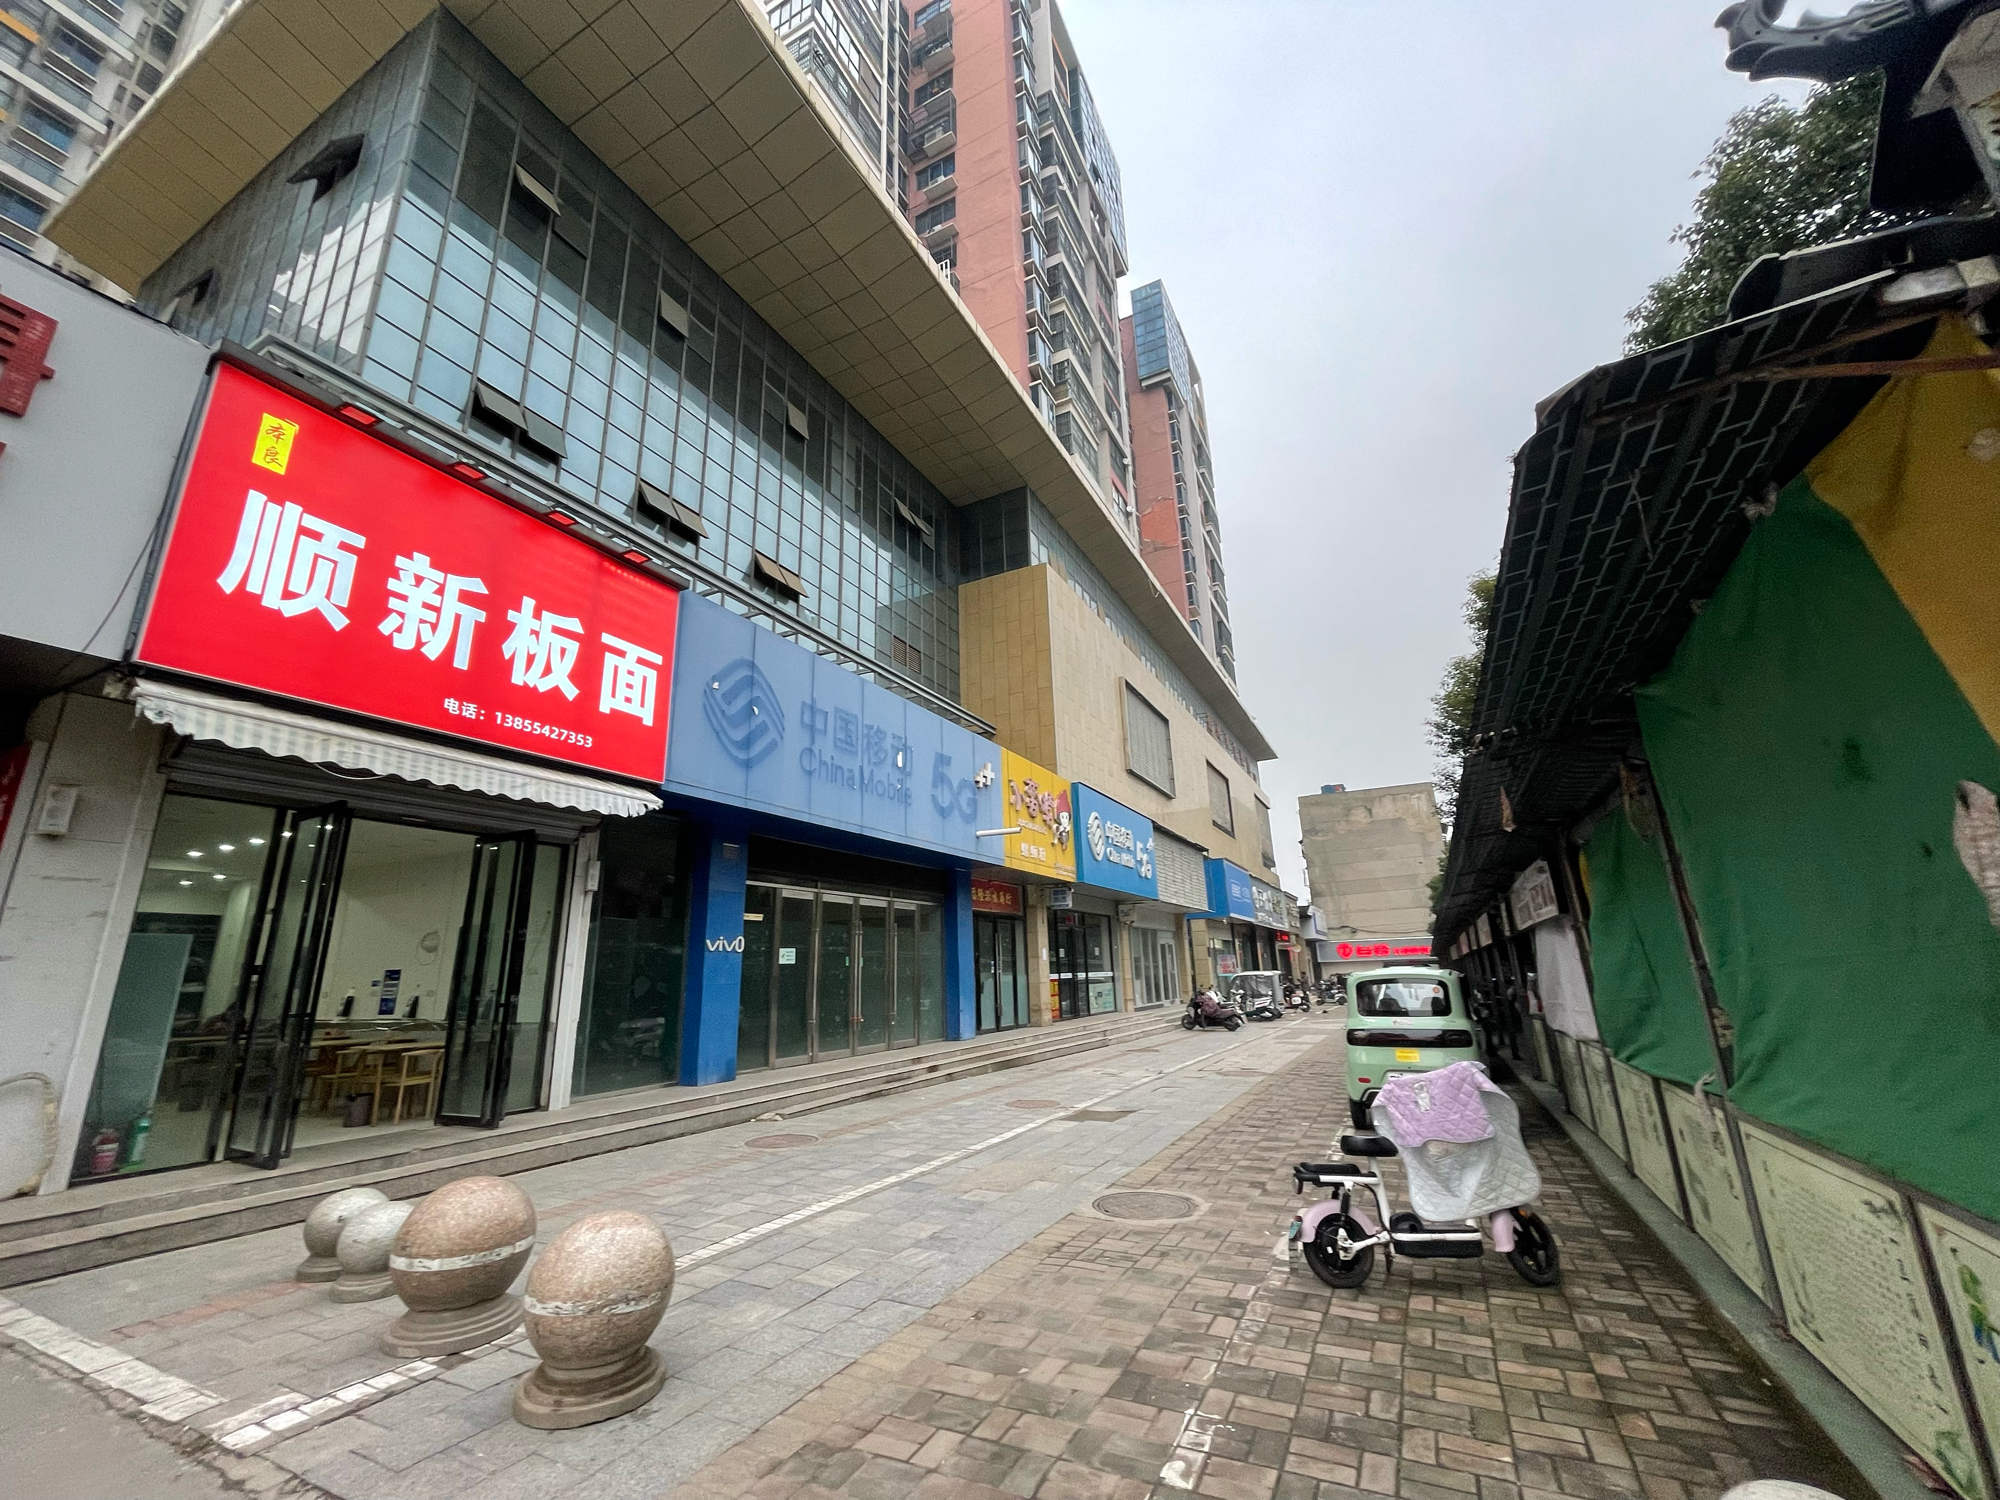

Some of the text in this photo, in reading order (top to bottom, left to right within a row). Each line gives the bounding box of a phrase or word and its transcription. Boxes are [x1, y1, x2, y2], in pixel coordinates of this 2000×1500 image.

[216, 488, 664, 727] 顺新板面
[801, 697, 914, 777] 中国移动
[800, 747, 913, 807] China Mobile
[1105, 820, 1134, 851] 中国移动
